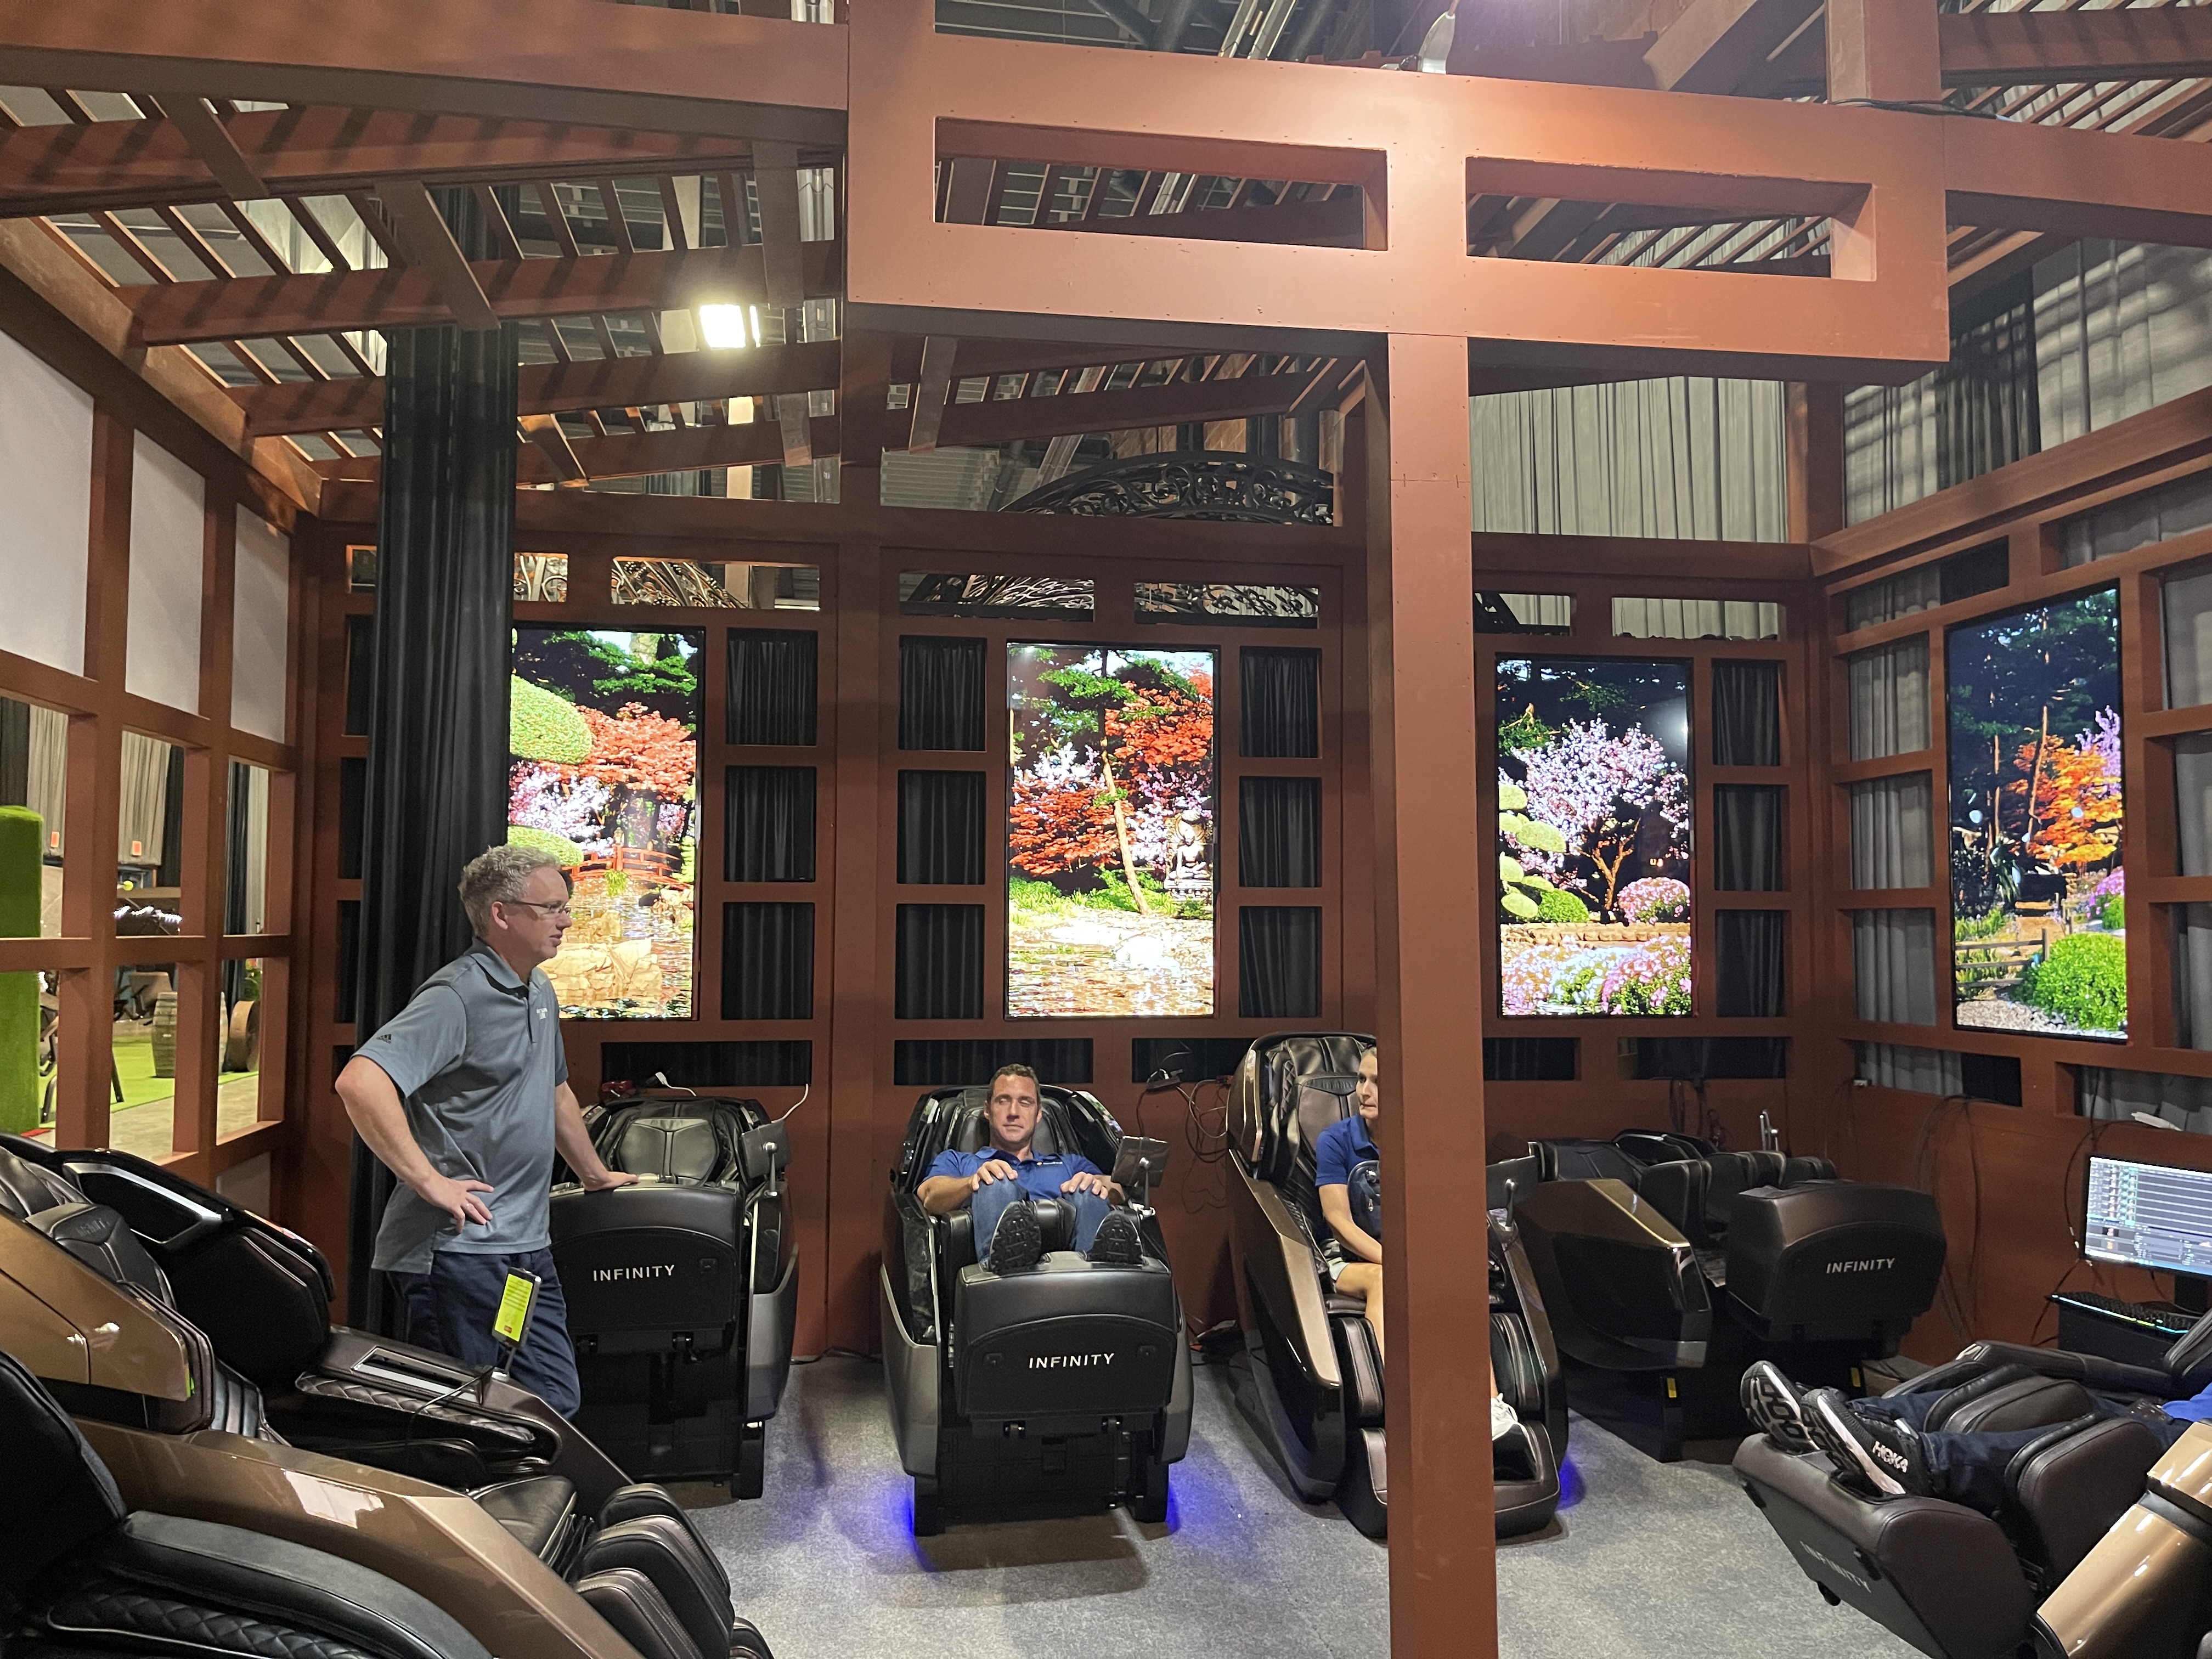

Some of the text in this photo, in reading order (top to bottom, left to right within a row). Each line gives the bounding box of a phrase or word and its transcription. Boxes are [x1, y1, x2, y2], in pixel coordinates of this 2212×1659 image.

[593, 1265, 675, 1282] INFINITY
[1826, 1257, 1895, 1274] INFINITY
[1029, 1353, 1114, 1369] INFINITY
[1872, 1440, 1909, 1474] HOKA
